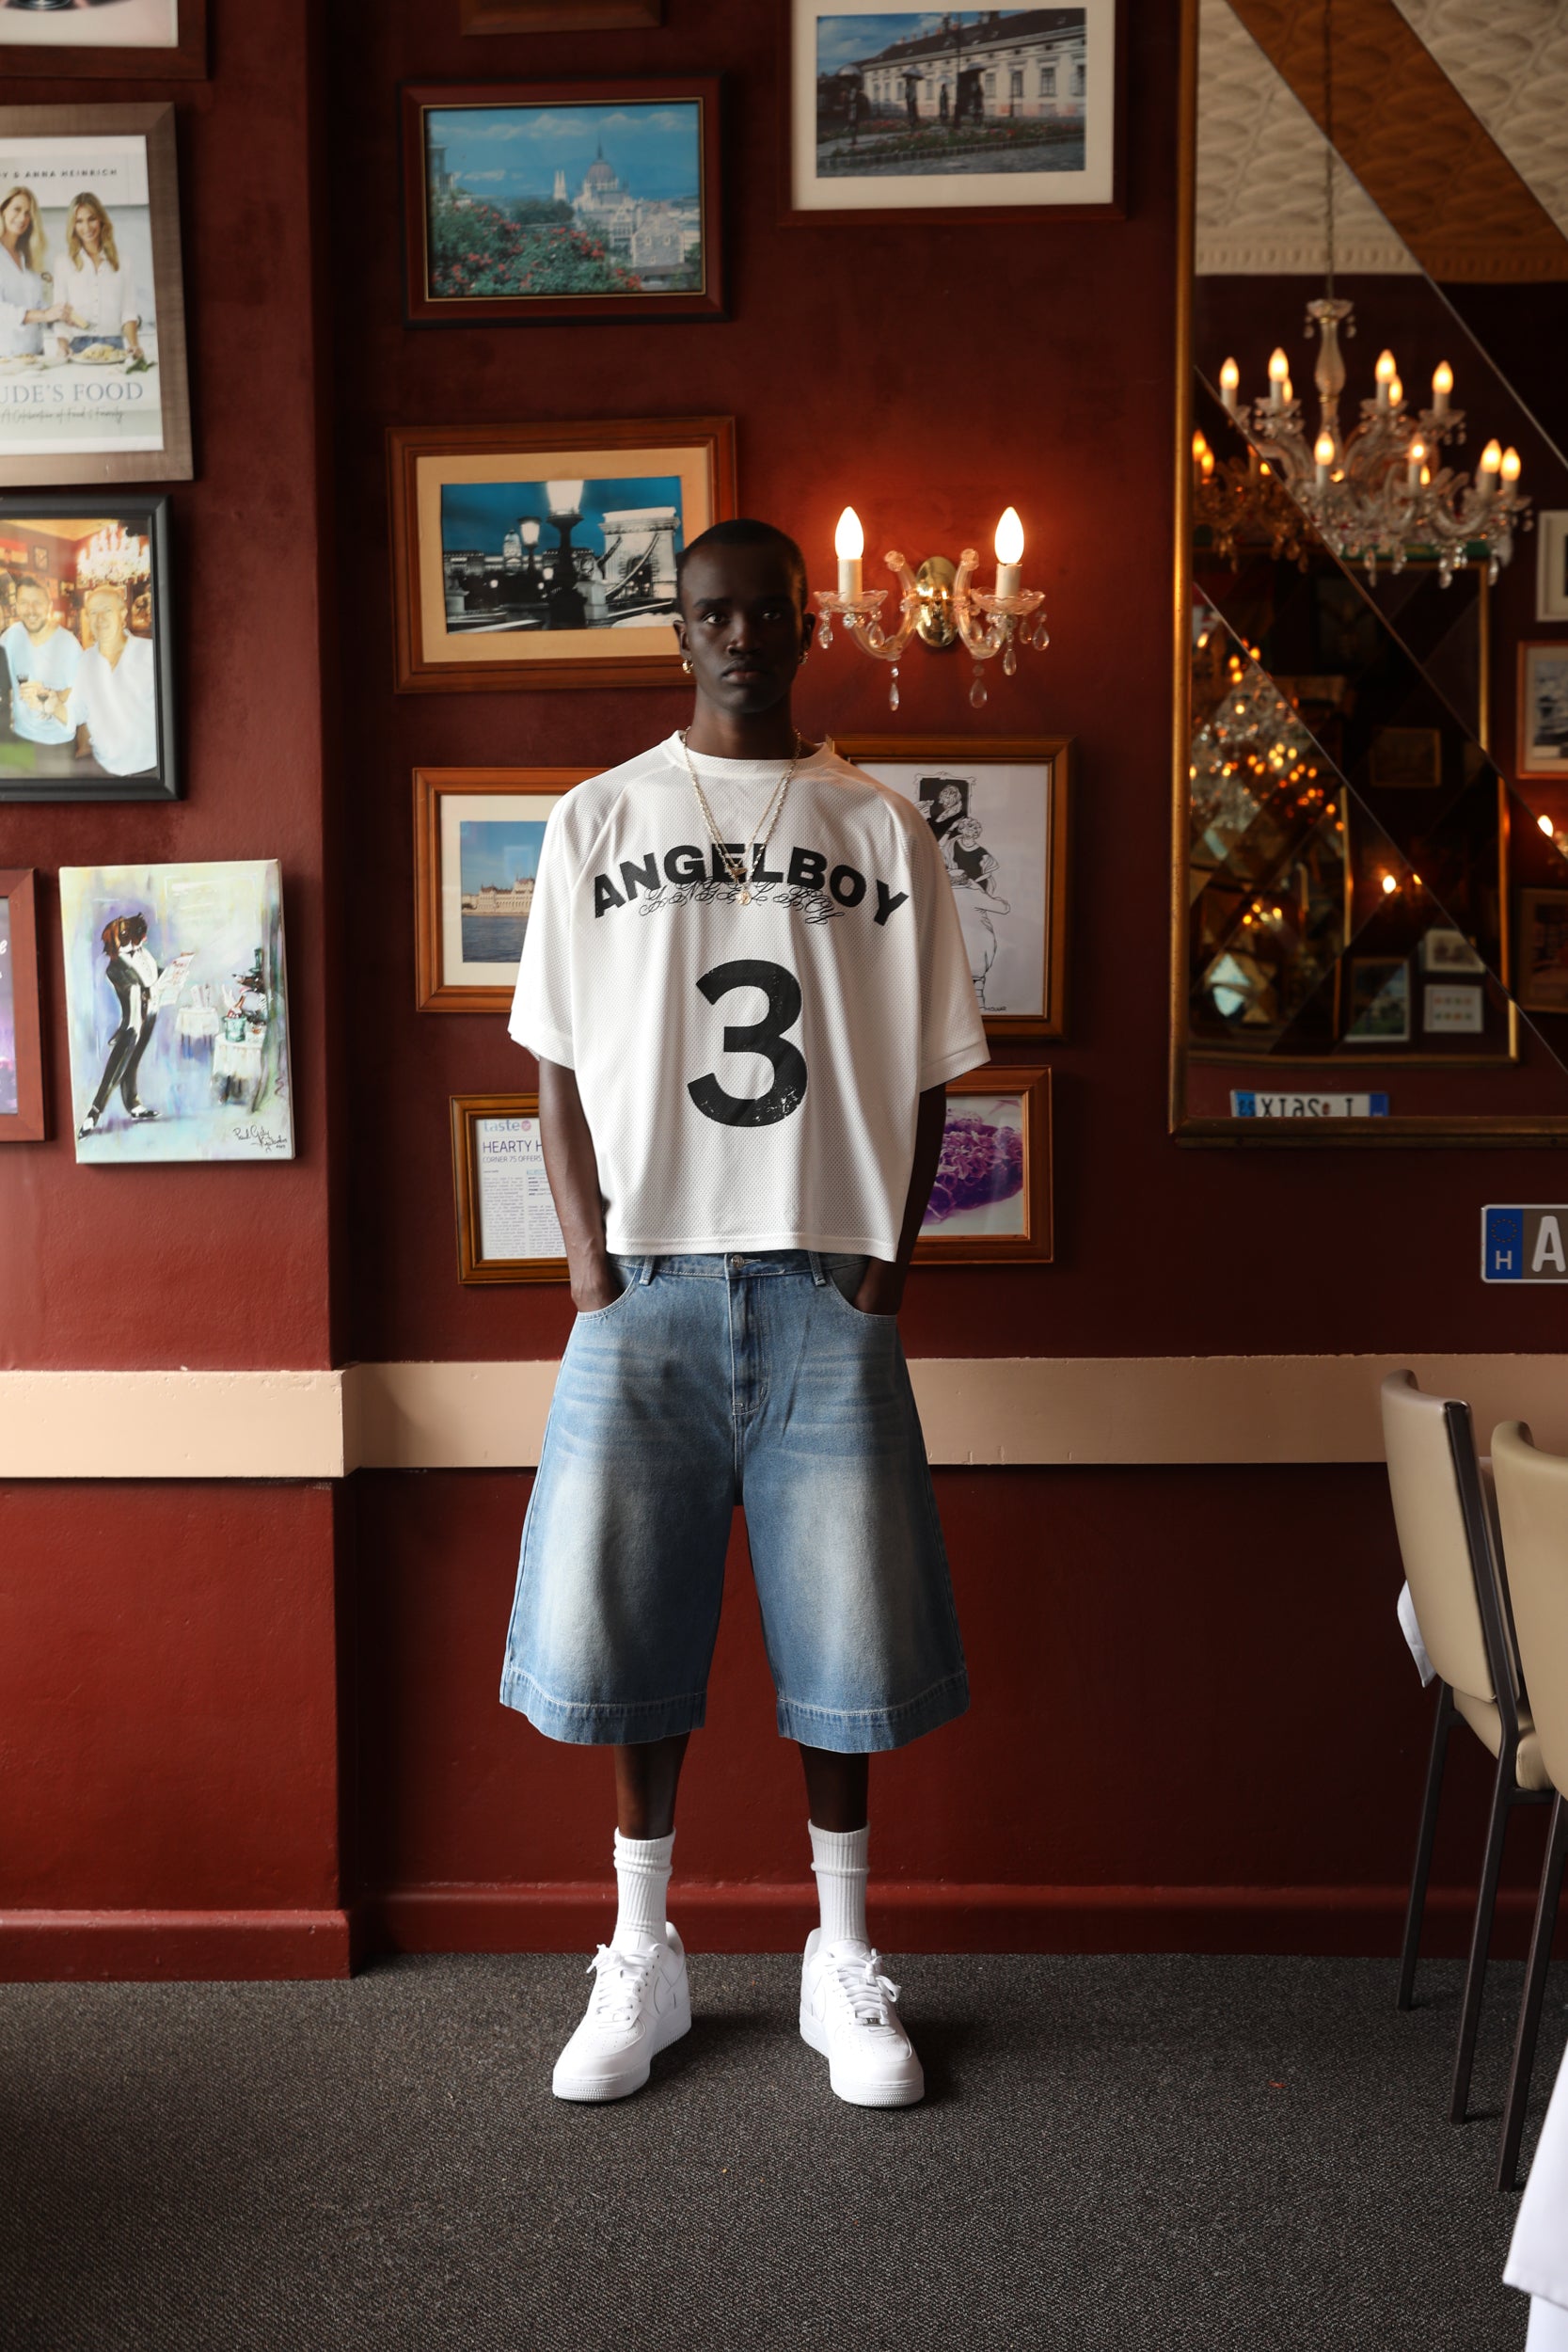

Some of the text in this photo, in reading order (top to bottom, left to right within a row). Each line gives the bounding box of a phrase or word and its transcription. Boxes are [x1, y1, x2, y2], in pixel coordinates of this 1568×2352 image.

[24, 169, 56, 179] ANNA
[72, 381, 144, 403] FOOD
[594, 842, 910, 927] ANGELBOY
[687, 959, 809, 1128] 3
[483, 1119, 520, 1132] taste
[482, 1139, 532, 1153] HEARTY
[482, 1155, 508, 1164] CORNER
[517, 1154, 543, 1163] OFFERS
[1495, 1215, 1567, 1273] H A
